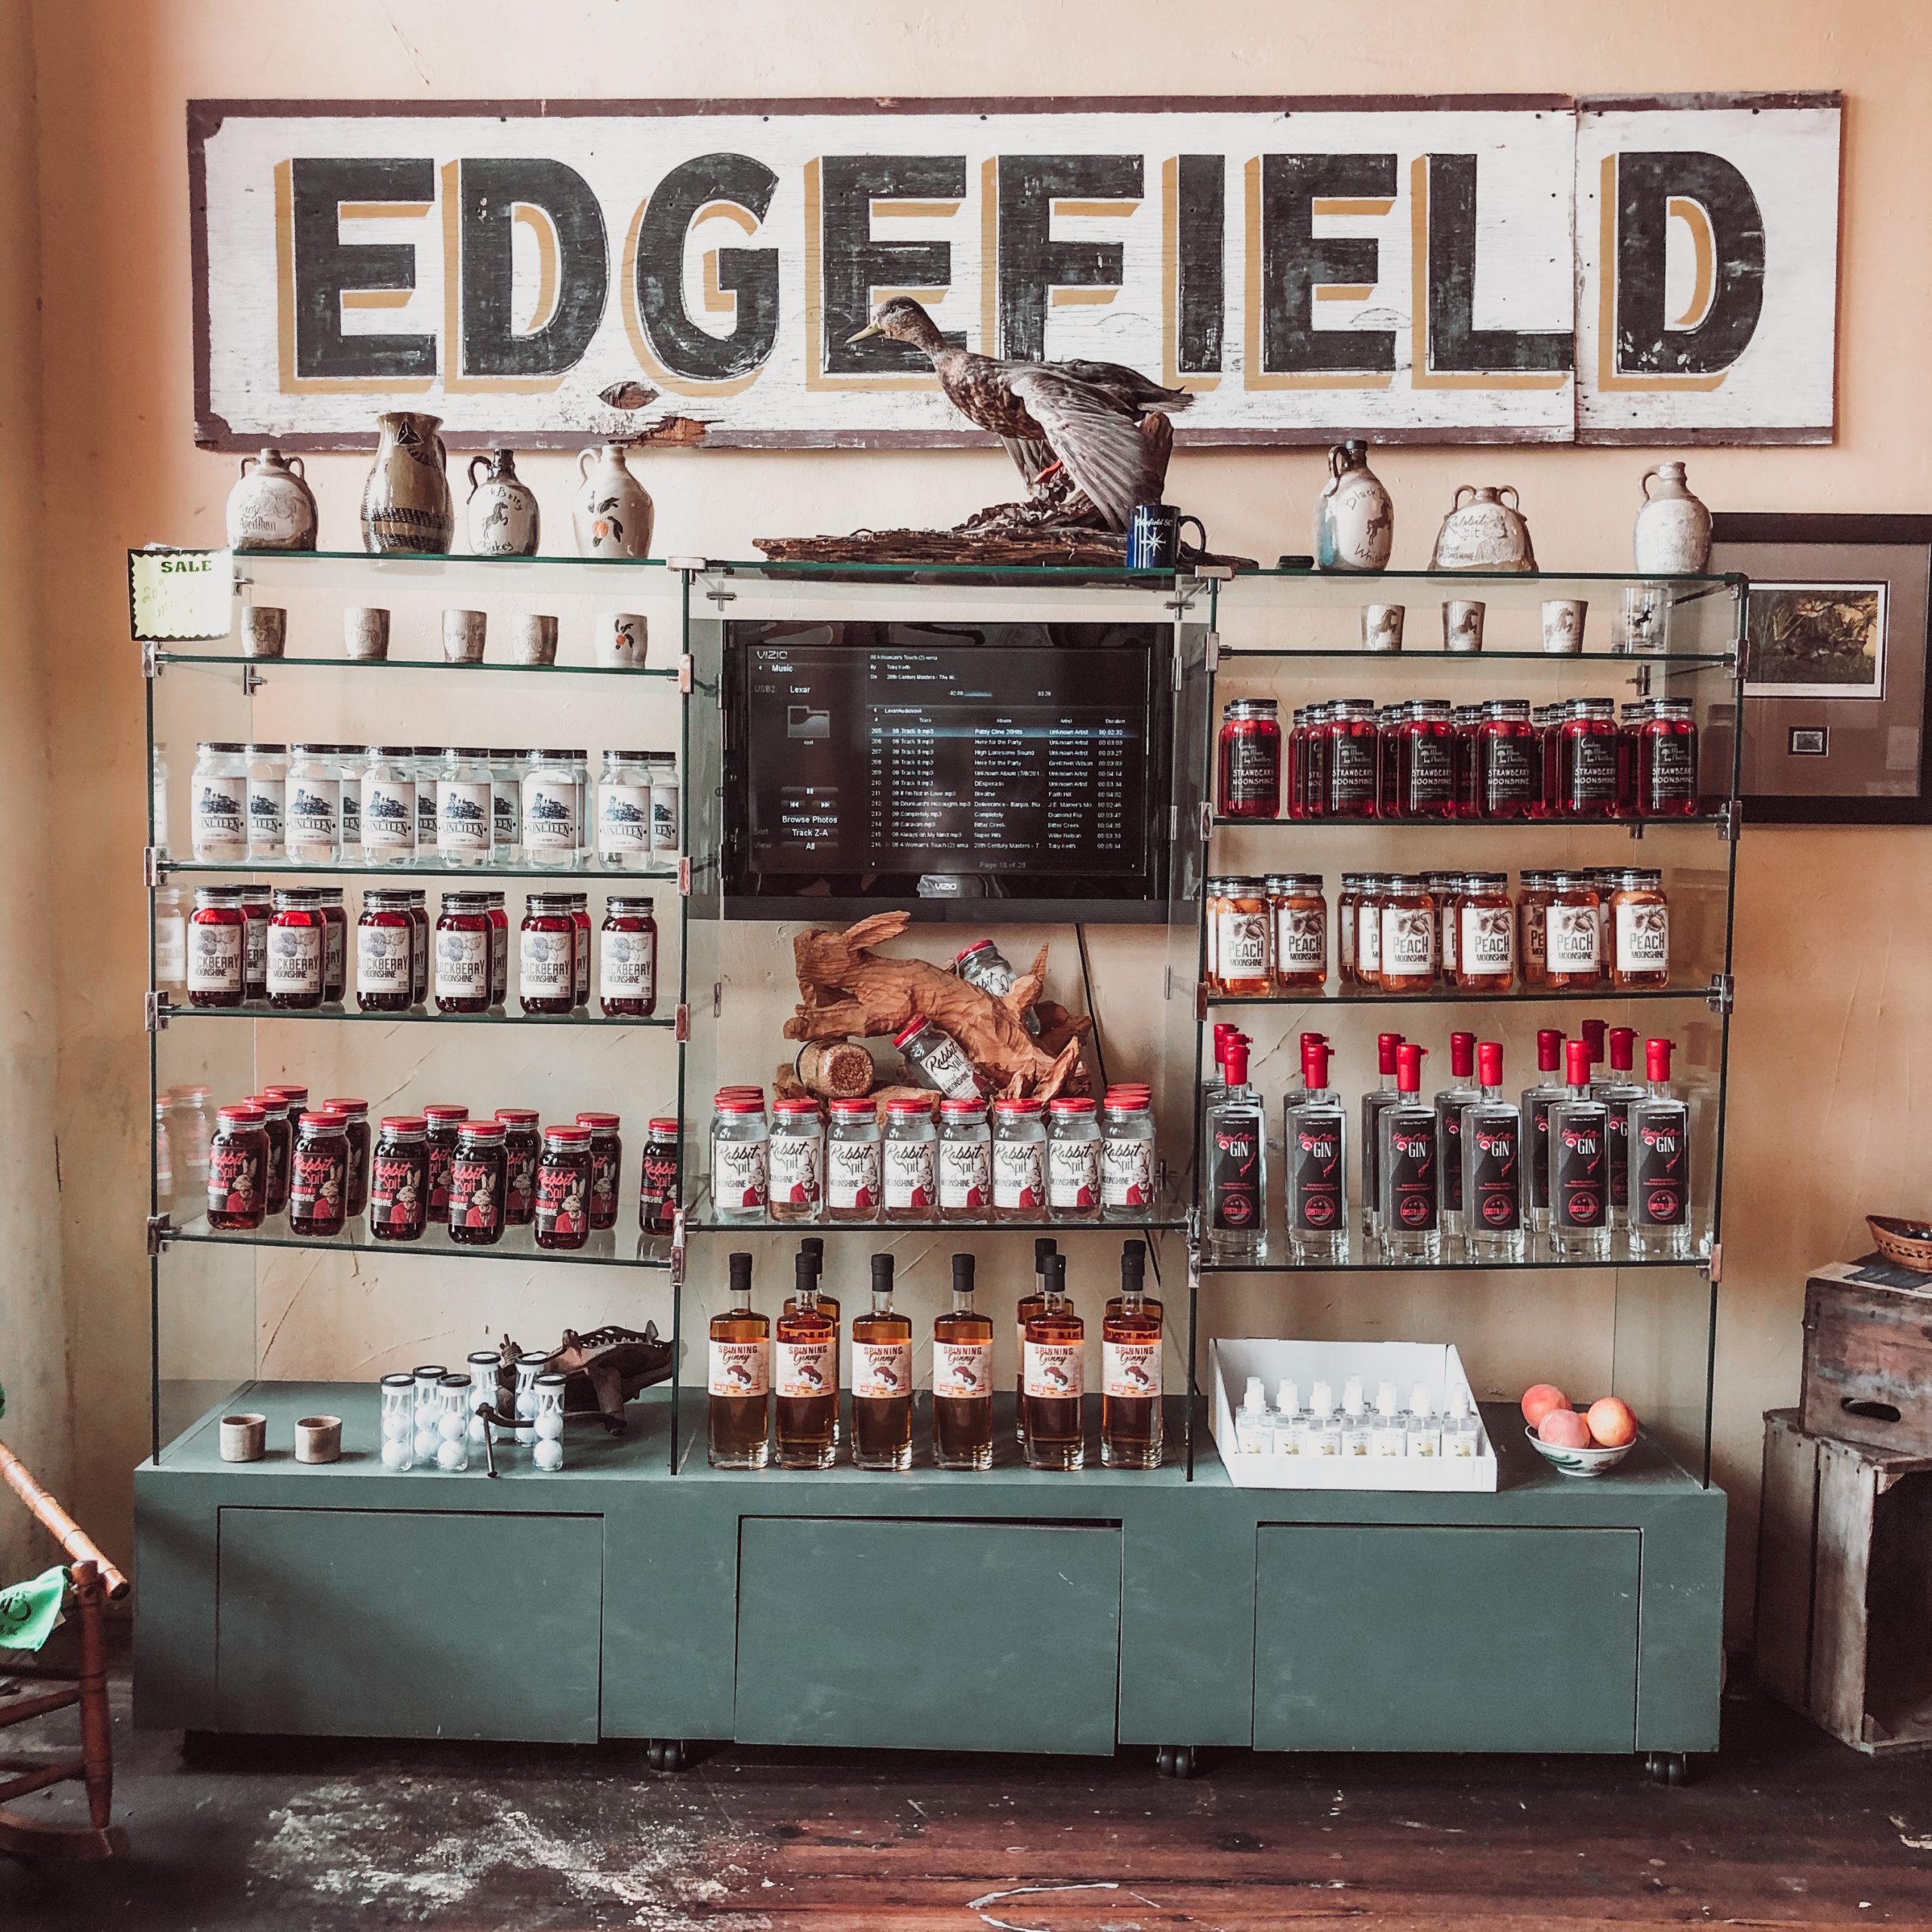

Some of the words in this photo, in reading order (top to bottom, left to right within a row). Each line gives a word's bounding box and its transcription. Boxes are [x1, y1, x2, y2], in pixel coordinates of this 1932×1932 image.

[275, 151, 1766, 395] EDGEFIELD
[1137, 518, 1164, 528] Eefield
[161, 560, 212, 574] SALE
[756, 651, 788, 660] VIZIO
[771, 664, 793, 672] Music
[789, 685, 811, 694] Lexar
[792, 829, 813, 837] Track
[805, 842, 815, 851] All
[934, 882, 957, 891] VIZIO
[1288, 935, 1321, 952] PEACH
[1393, 936, 1429, 954] PEACH
[1475, 934, 1509, 952] PEACH
[1557, 933, 1593, 951] PEACH
[1630, 931, 1665, 950] PEACH
[1229, 940, 1263, 958] PEACH
[1631, 950, 1664, 959] MOONSHINE
[196, 954, 239, 969] CKBERRY
[1290, 952, 1321, 961] MOONSHINE
[1395, 954, 1428, 962] MOONSHINE
[1476, 953, 1509, 961] MOONSHINE
[1558, 951, 1593, 960] MOONSHINE
[1230, 958, 1263, 967] MOONSHINE
[194, 968, 227, 977] MOONSHINE
[272, 969, 308, 979] MOONSHINE
[362, 970, 397, 980] MOONSHINE
[440, 974, 473, 983] MOONSHINE
[526, 975, 558, 984] MOONSHINE
[607, 975, 640, 984] MOONSHINE
[926, 1041, 958, 1072] Rabbit
[945, 1070, 971, 1094] MOONSHINE
[770, 1139, 810, 1162] Rabbit
[1230, 1141, 1248, 1157] GIN
[1313, 1142, 1331, 1158] GIN
[1408, 1142, 1426, 1158] GIN
[1491, 1141, 1509, 1157] GIN
[1577, 1138, 1595, 1154] GIN
[1656, 1137, 1675, 1153] GIN
[717, 1143, 761, 1167] Rabbit
[831, 1143, 875, 1166] Rabbit
[886, 1143, 930, 1166] Rabbit
[941, 1143, 984, 1166] Rabbit
[995, 1143, 1038, 1166] Rabbit
[1051, 1143, 1094, 1166] Rabbit
[1102, 1140, 1142, 1164] Rabbit
[718, 1345, 758, 1354] SPINNING
[789, 1345, 827, 1355] SPINNING
[864, 1346, 903, 1355] SPINNING
[943, 1346, 983, 1355] SPINNING
[1035, 1346, 1073, 1355] SPINNING
[1115, 1346, 1154, 1355] SPINNING
